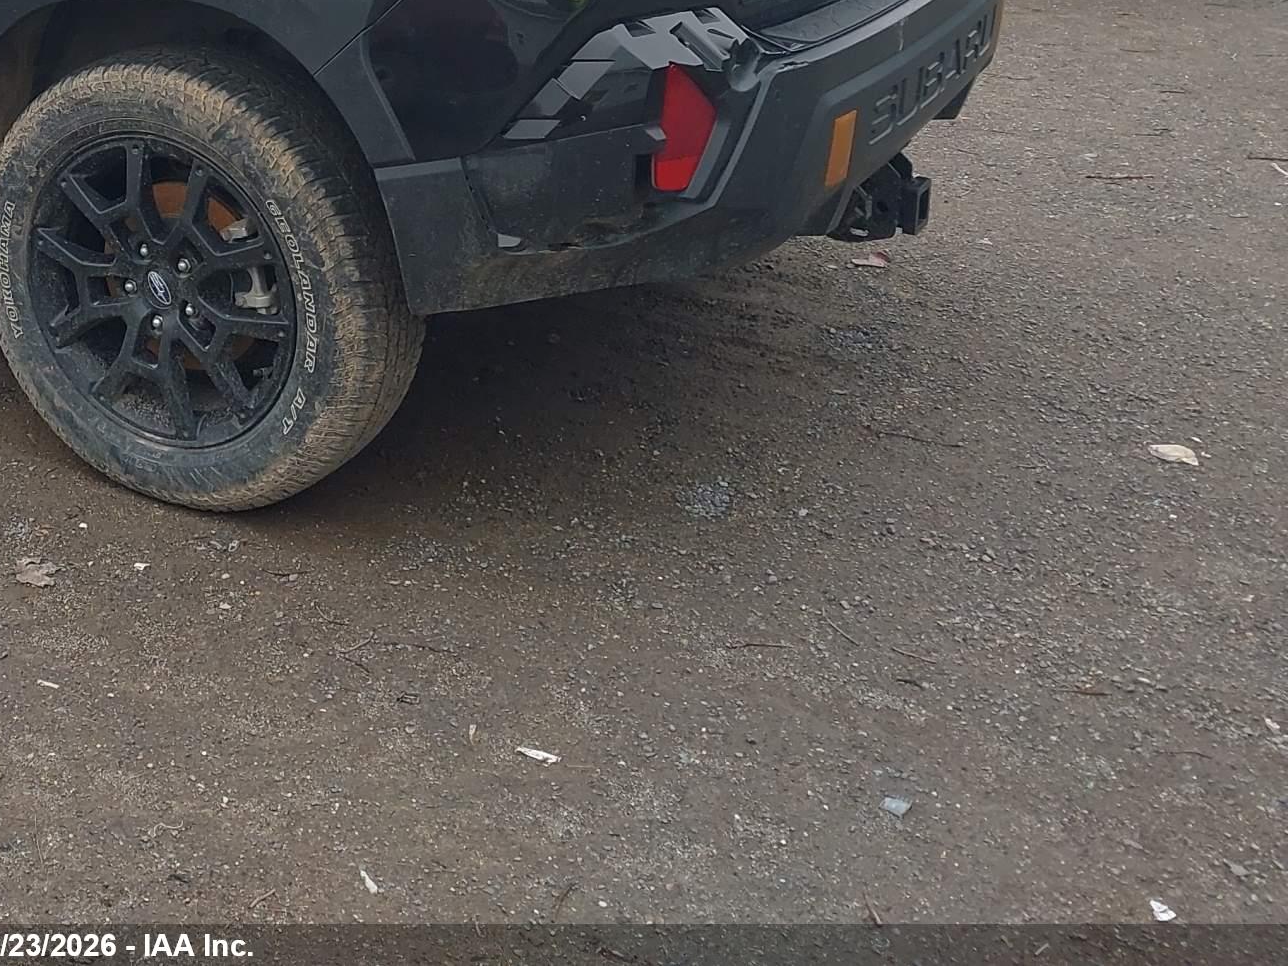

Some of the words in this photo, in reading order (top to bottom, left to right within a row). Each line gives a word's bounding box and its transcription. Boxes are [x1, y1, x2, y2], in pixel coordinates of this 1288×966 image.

[868, 3, 998, 146] SUBARU
[265, 199, 318, 374] GEOLANDAR
[281, 386, 307, 436] A/T
